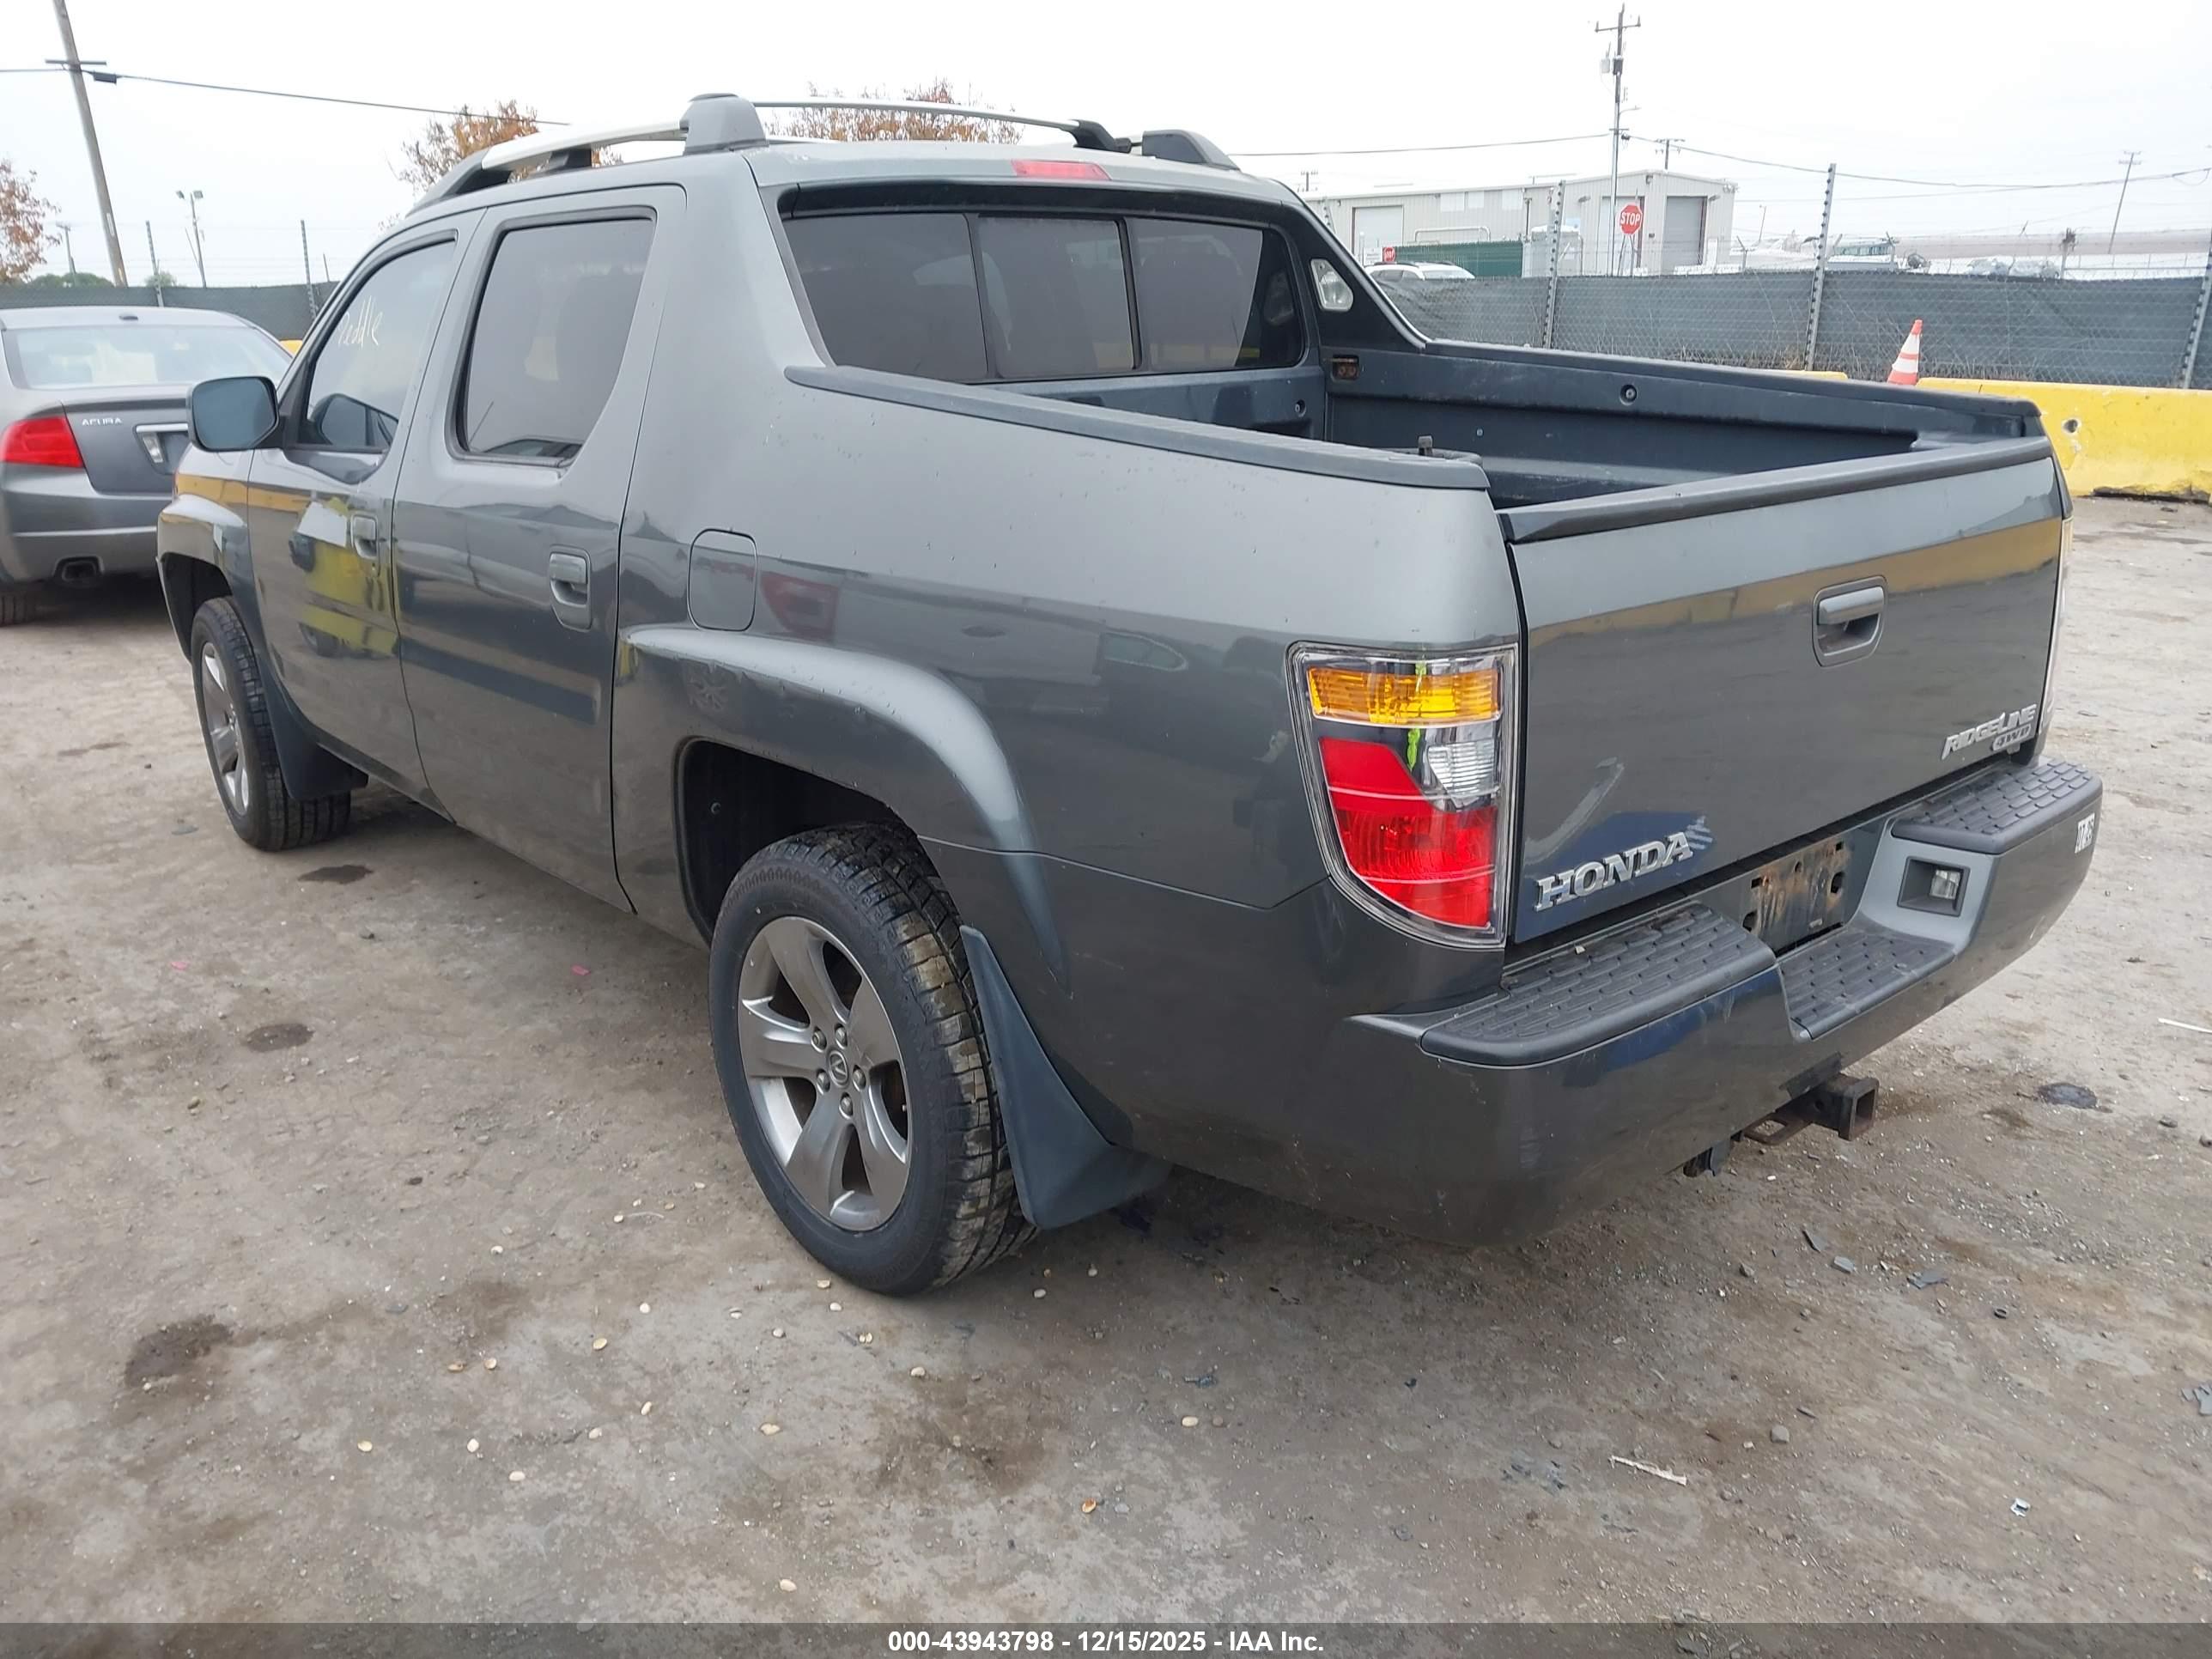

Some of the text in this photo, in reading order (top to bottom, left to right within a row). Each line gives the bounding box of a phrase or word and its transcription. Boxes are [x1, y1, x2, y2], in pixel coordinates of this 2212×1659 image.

[1621, 212, 1640, 226] STOP
[82, 417, 123, 426] ACURA
[1942, 703, 2037, 761] RIDGELINE
[1534, 831, 1693, 912] HONDA
